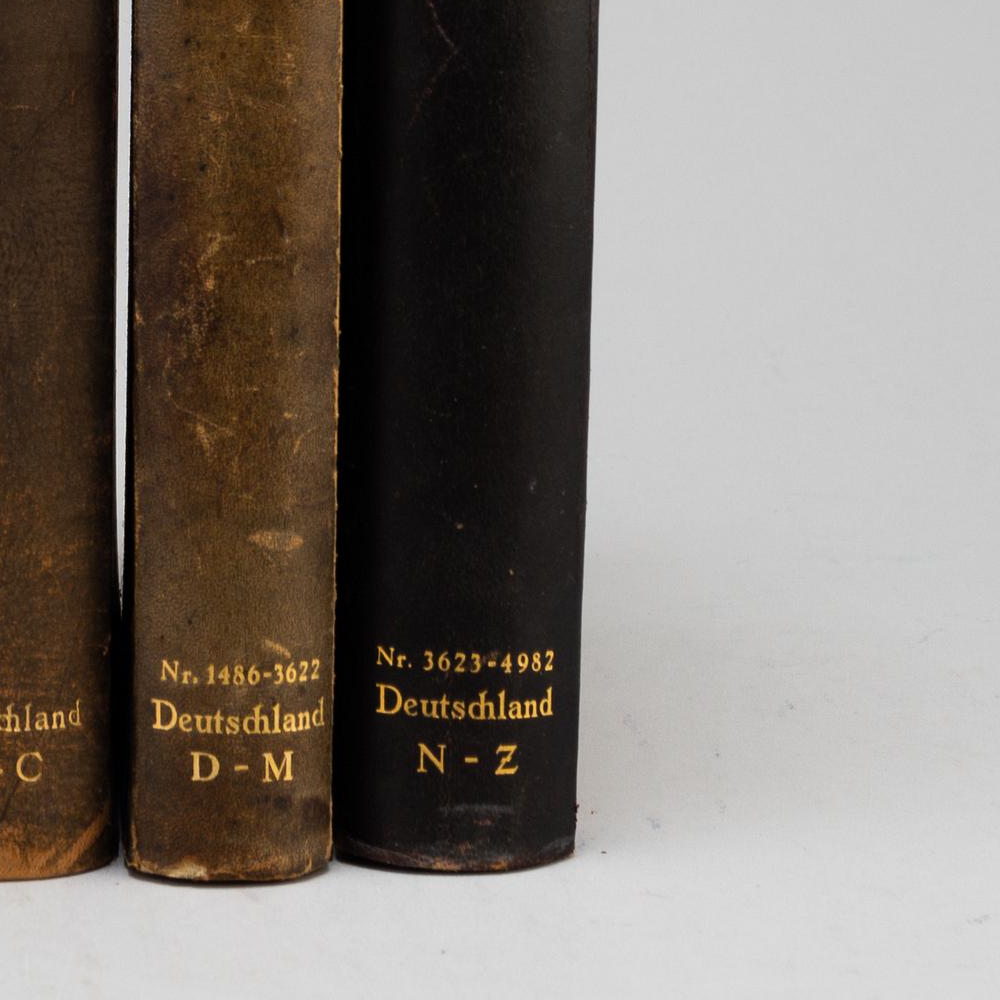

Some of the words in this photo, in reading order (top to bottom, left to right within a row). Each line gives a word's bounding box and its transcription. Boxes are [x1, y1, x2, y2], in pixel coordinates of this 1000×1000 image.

[160, 660, 198, 684] Nr.
[207, 658, 320, 685] 1486-3622
[376, 646, 412, 669] Nr.
[423, 651, 554, 674] 3623-4982
[152, 696, 325, 735] Deutschland
[376, 683, 553, 720] Deutschland
[16, 751, 43, 782] C
[191, 751, 220, 782] D
[263, 751, 293, 783] M
[417, 743, 446, 774] N
[495, 744, 518, 776] Z
